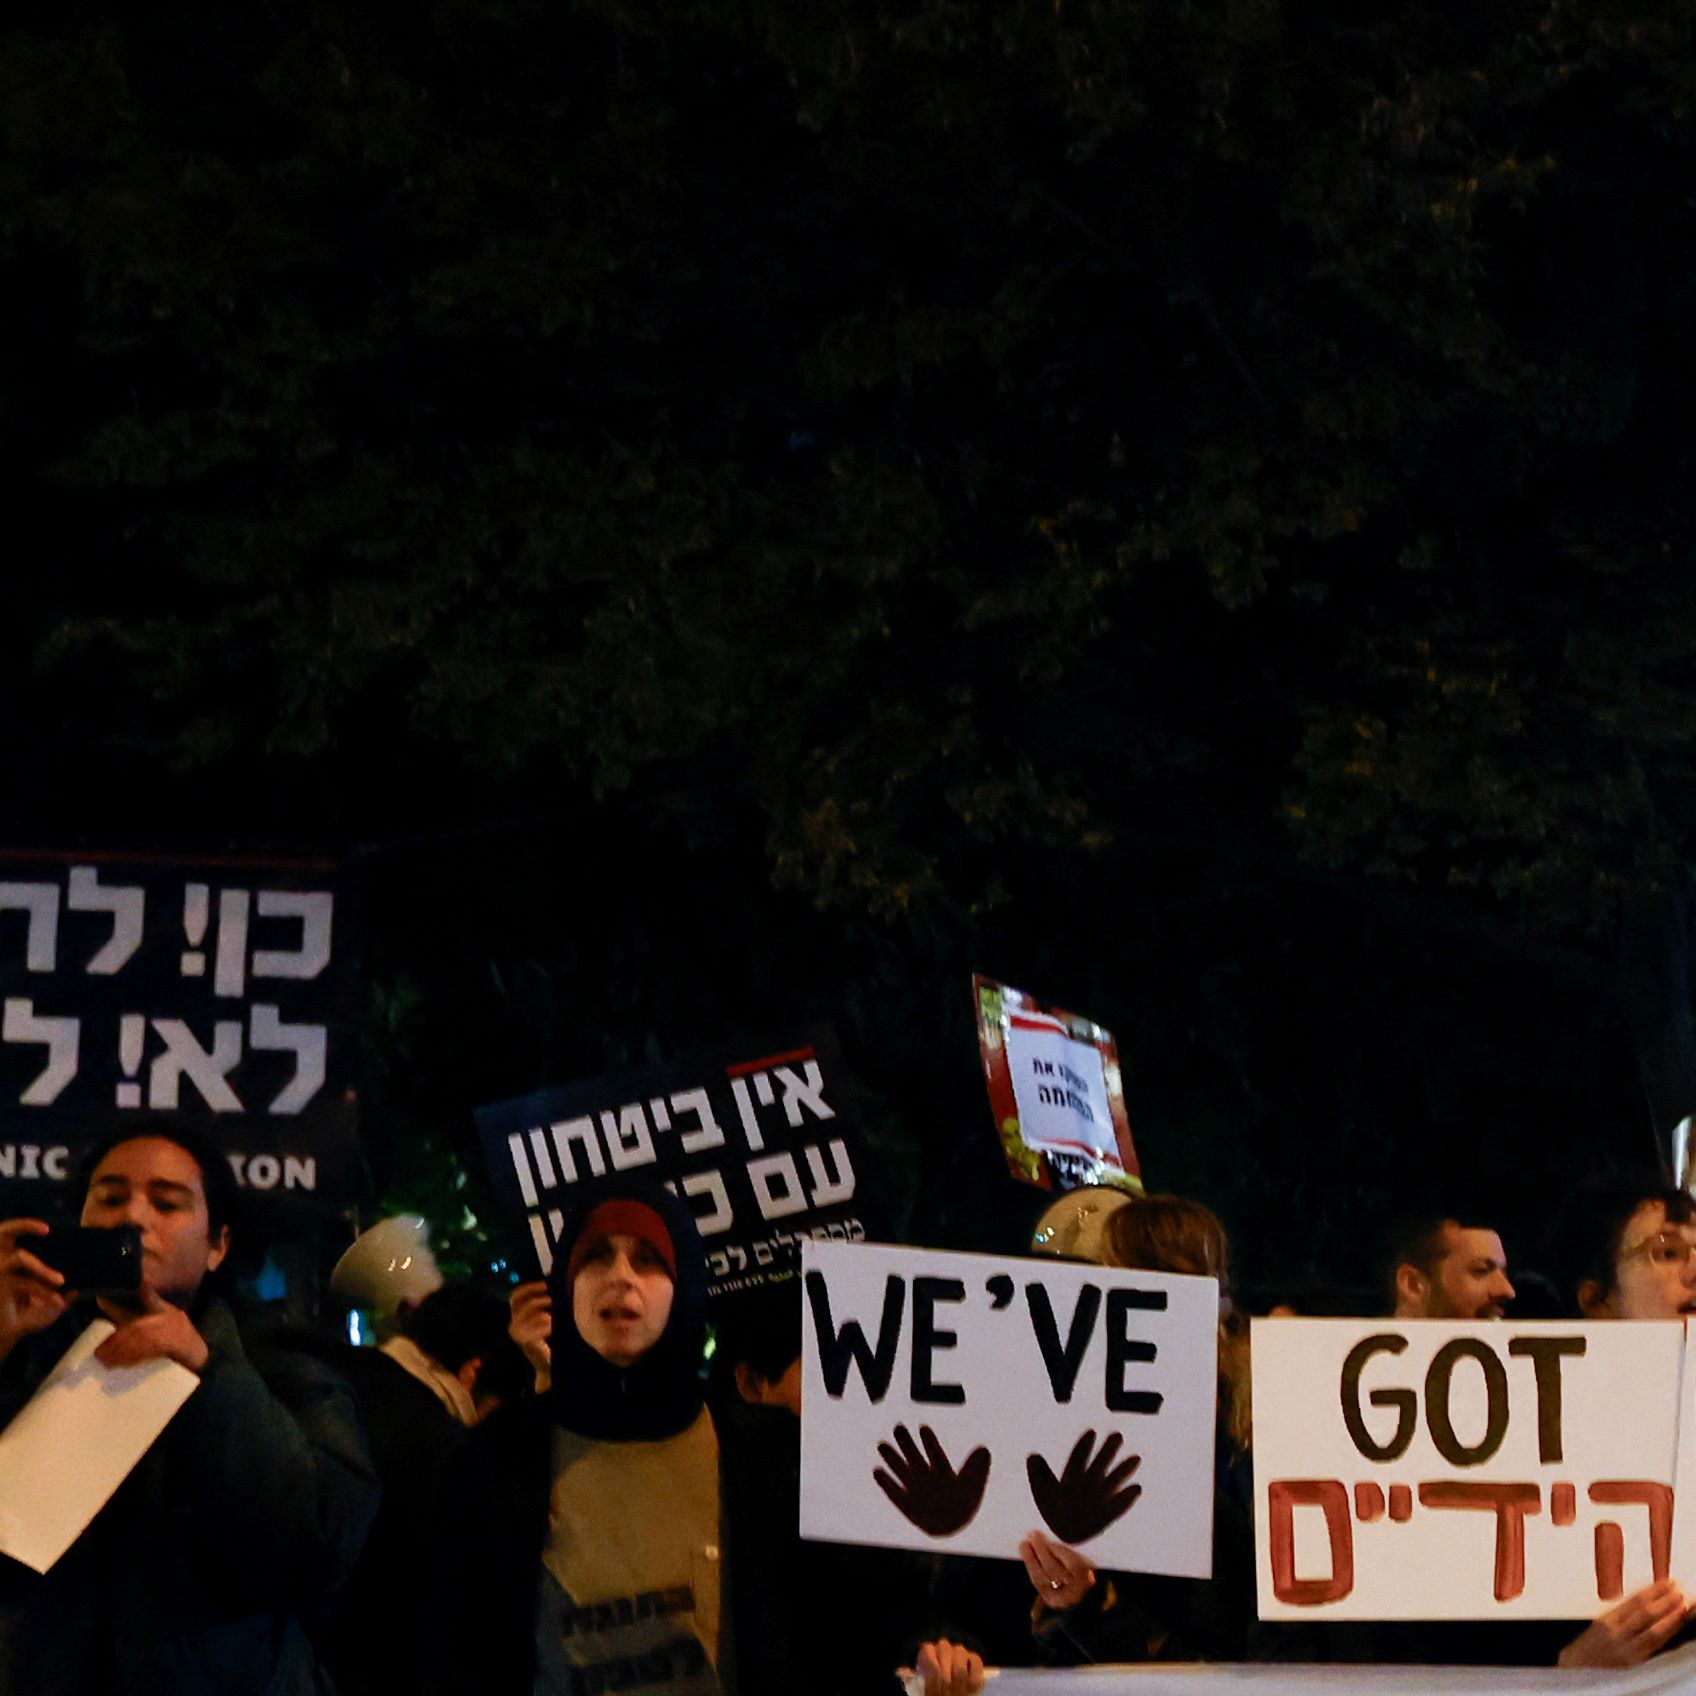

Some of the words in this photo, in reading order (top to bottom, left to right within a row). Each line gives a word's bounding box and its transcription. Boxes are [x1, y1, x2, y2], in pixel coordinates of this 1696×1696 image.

[180, 883, 334, 998] כן!
[116, 1003, 328, 1116] לא!
[731, 1059, 837, 1151] אין
[508, 1087, 726, 1207] ביטחון
[746, 1138, 857, 1221] עם
[806, 1270, 1169, 1415] WE'VE
[1339, 1333, 1588, 1467] GOT
[1268, 1479, 1675, 1607] הידיים
